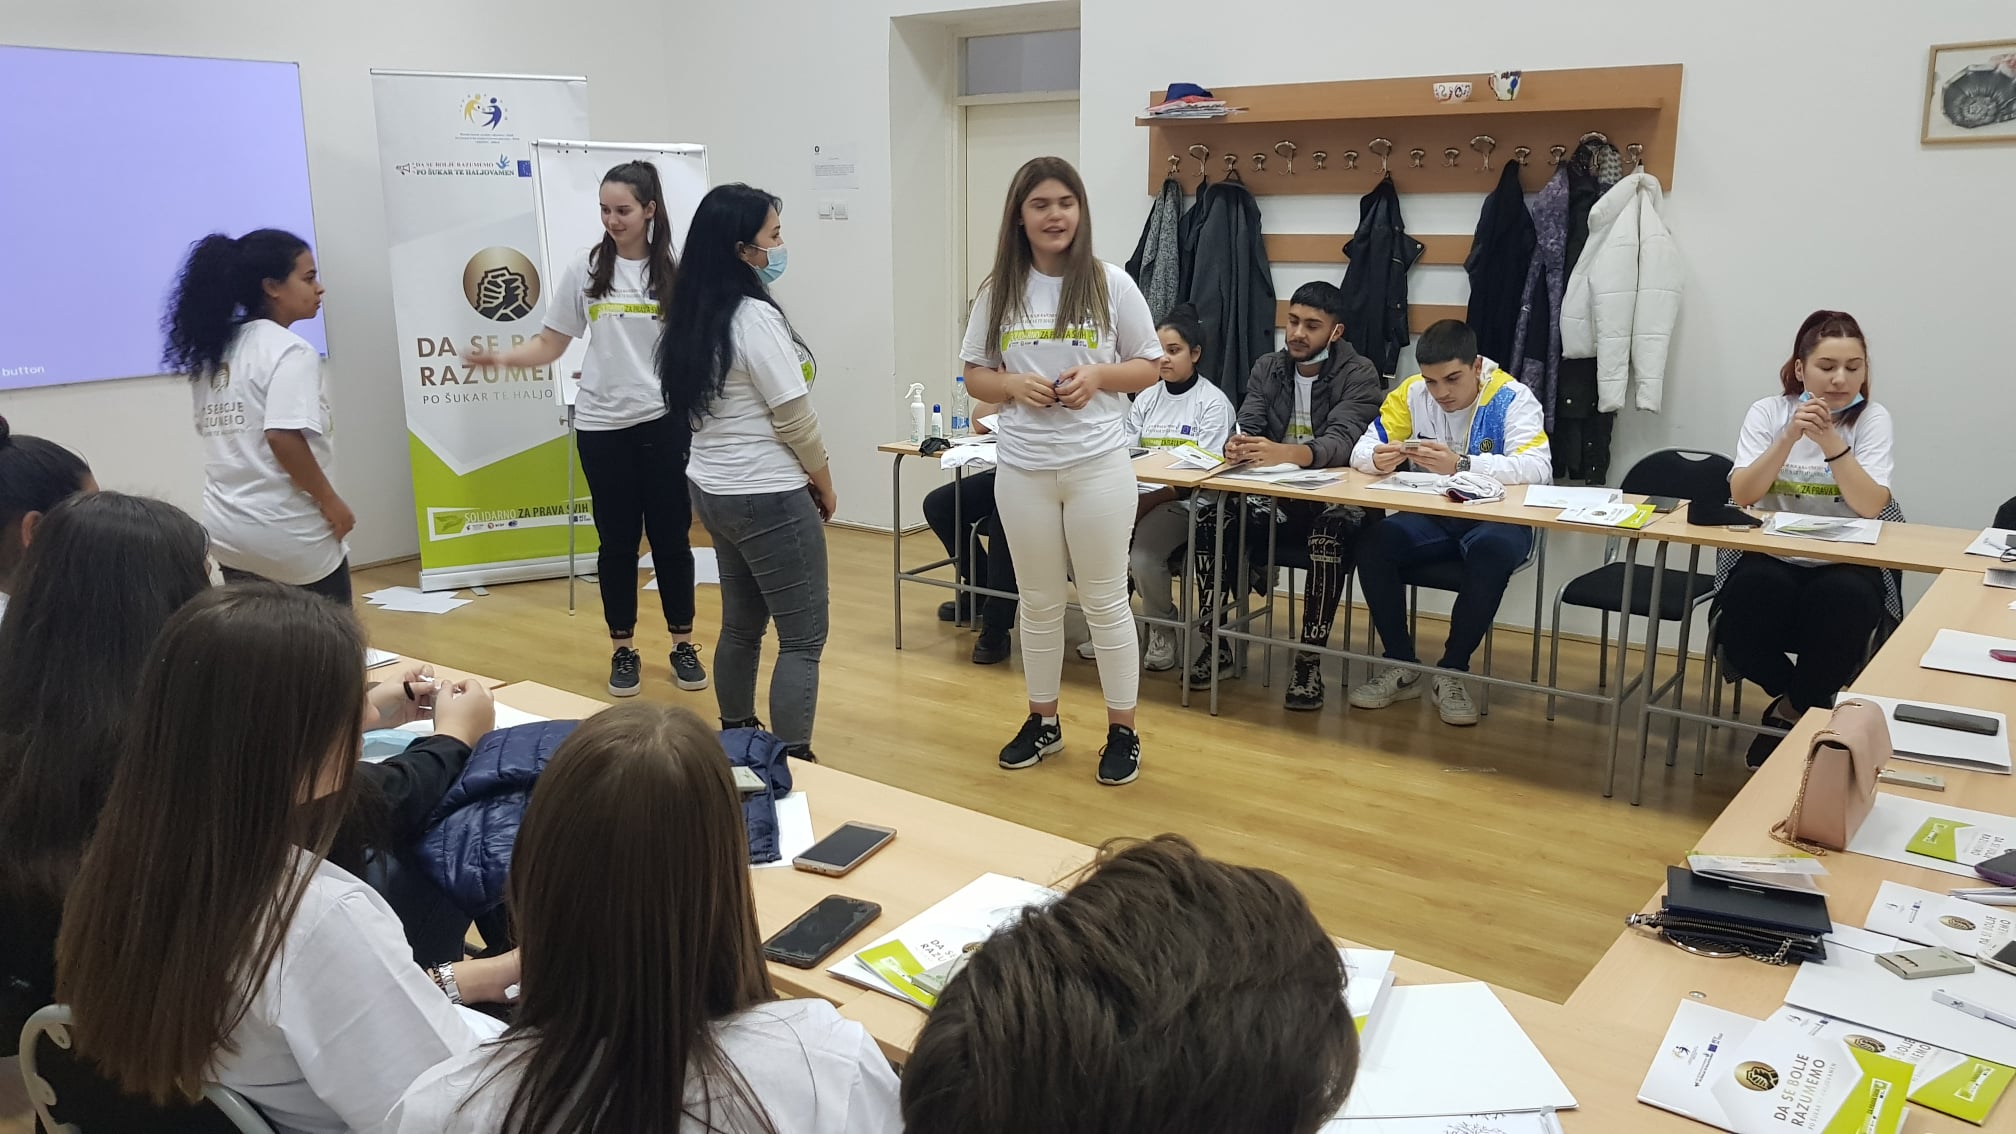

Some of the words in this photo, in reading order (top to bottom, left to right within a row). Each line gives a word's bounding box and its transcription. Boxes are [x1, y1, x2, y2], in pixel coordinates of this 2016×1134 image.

[417, 337, 457, 357] DA
[2, 367, 45, 376] button
[423, 395, 440, 404] PO
[445, 392, 488, 404] ŠUKAR
[494, 391, 507, 400] TE
[513, 389, 553, 400] HALJO
[464, 509, 516, 523] SOLIDARNO
[518, 508, 531, 518] ZA
[533, 505, 564, 517] PRAVA
[1787, 1053, 1809, 1087] BOLJE
[1782, 1087, 1796, 1102] SE
[1791, 1058, 1825, 1127] RAZUMEMO
[1774, 1105, 1790, 1121] DA
